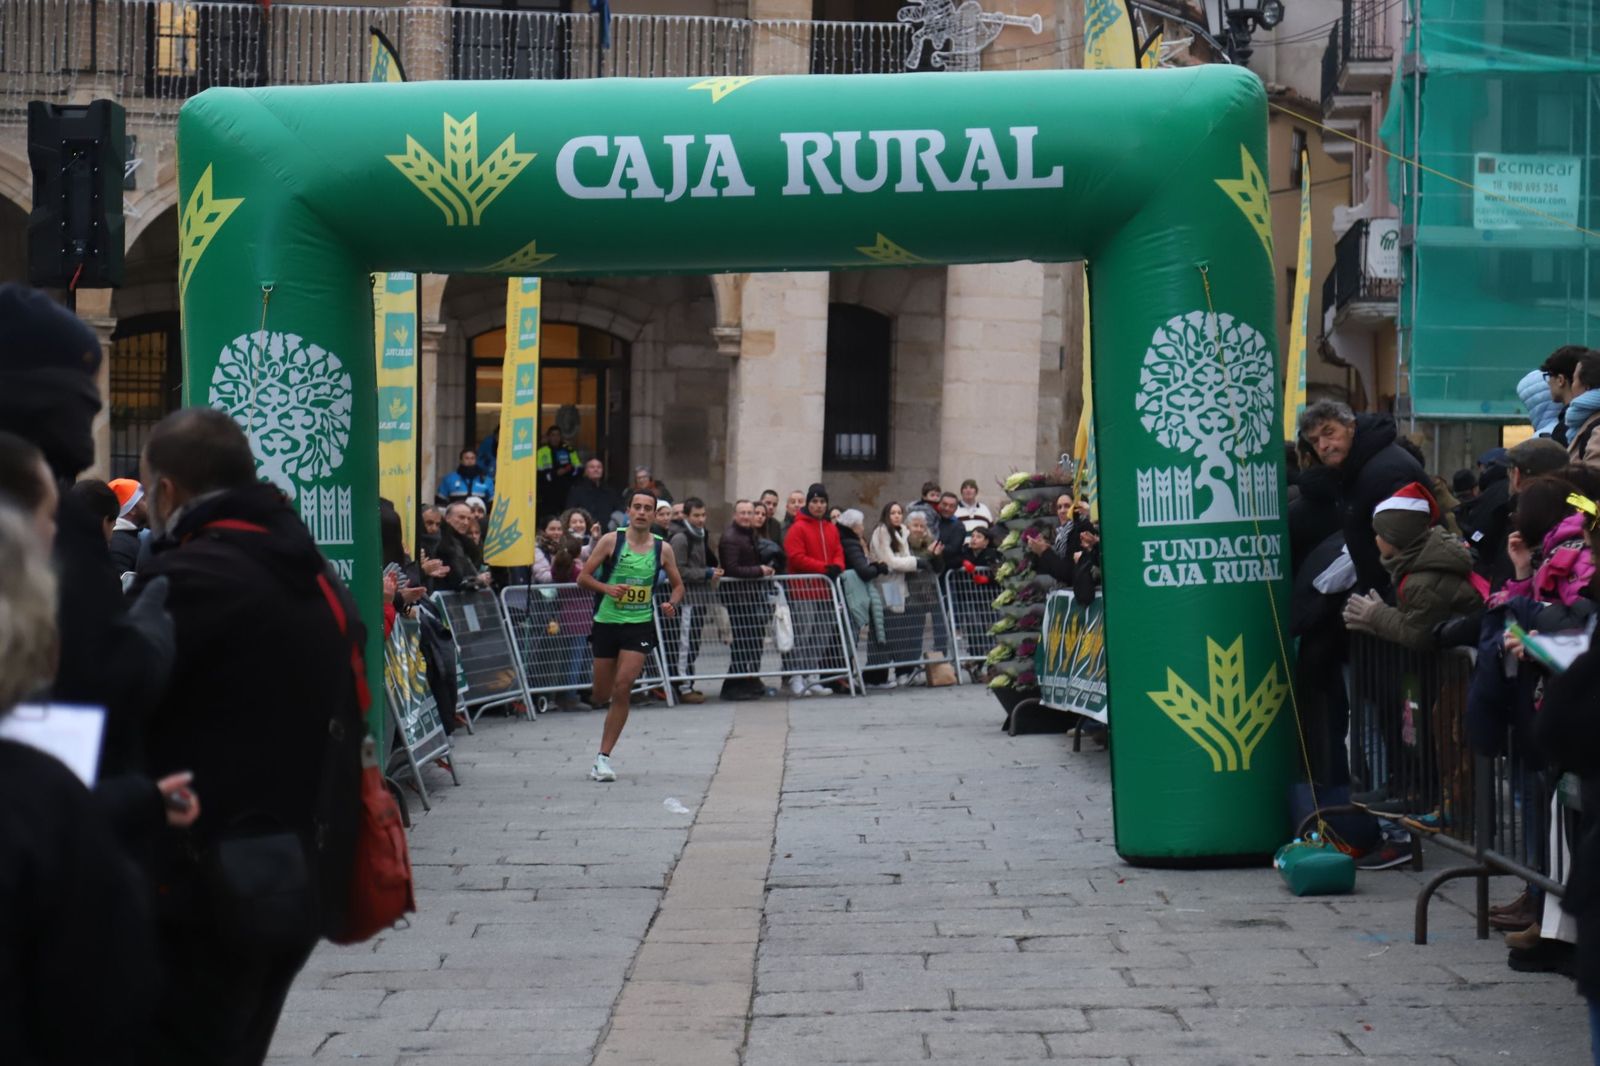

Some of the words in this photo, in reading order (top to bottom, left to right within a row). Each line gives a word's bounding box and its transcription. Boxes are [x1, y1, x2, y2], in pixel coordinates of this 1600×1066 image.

[555, 134, 756, 202] CAJA
[780, 126, 1064, 196] RURAL
[1141, 534, 1281, 562] FUNDACION
[1143, 563, 1207, 587] CAJA
[1212, 559, 1284, 584] RURAL
